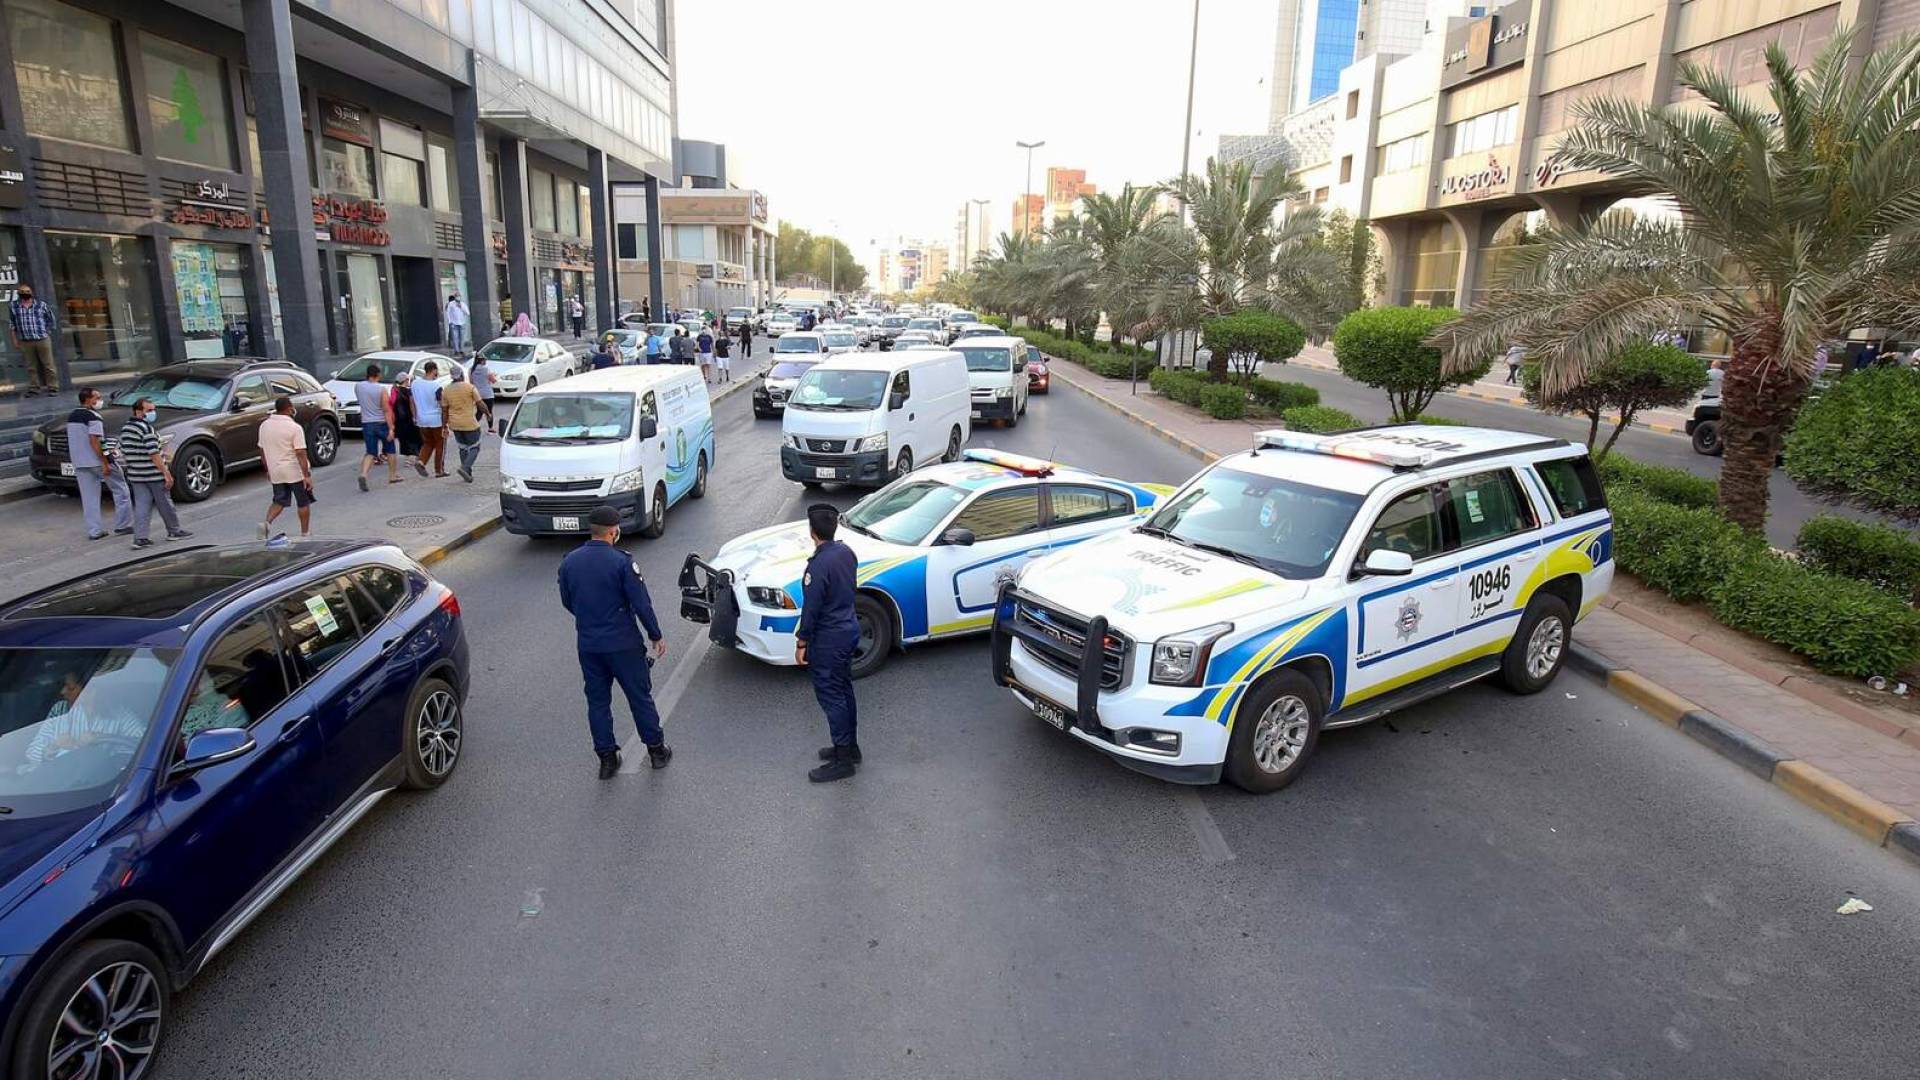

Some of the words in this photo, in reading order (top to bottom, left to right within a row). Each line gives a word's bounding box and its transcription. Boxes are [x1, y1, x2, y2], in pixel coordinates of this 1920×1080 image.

[198, 180, 229, 200] المركز
[1127, 550, 1202, 576] TRAFFIC
[1468, 564, 1511, 602] 10946
